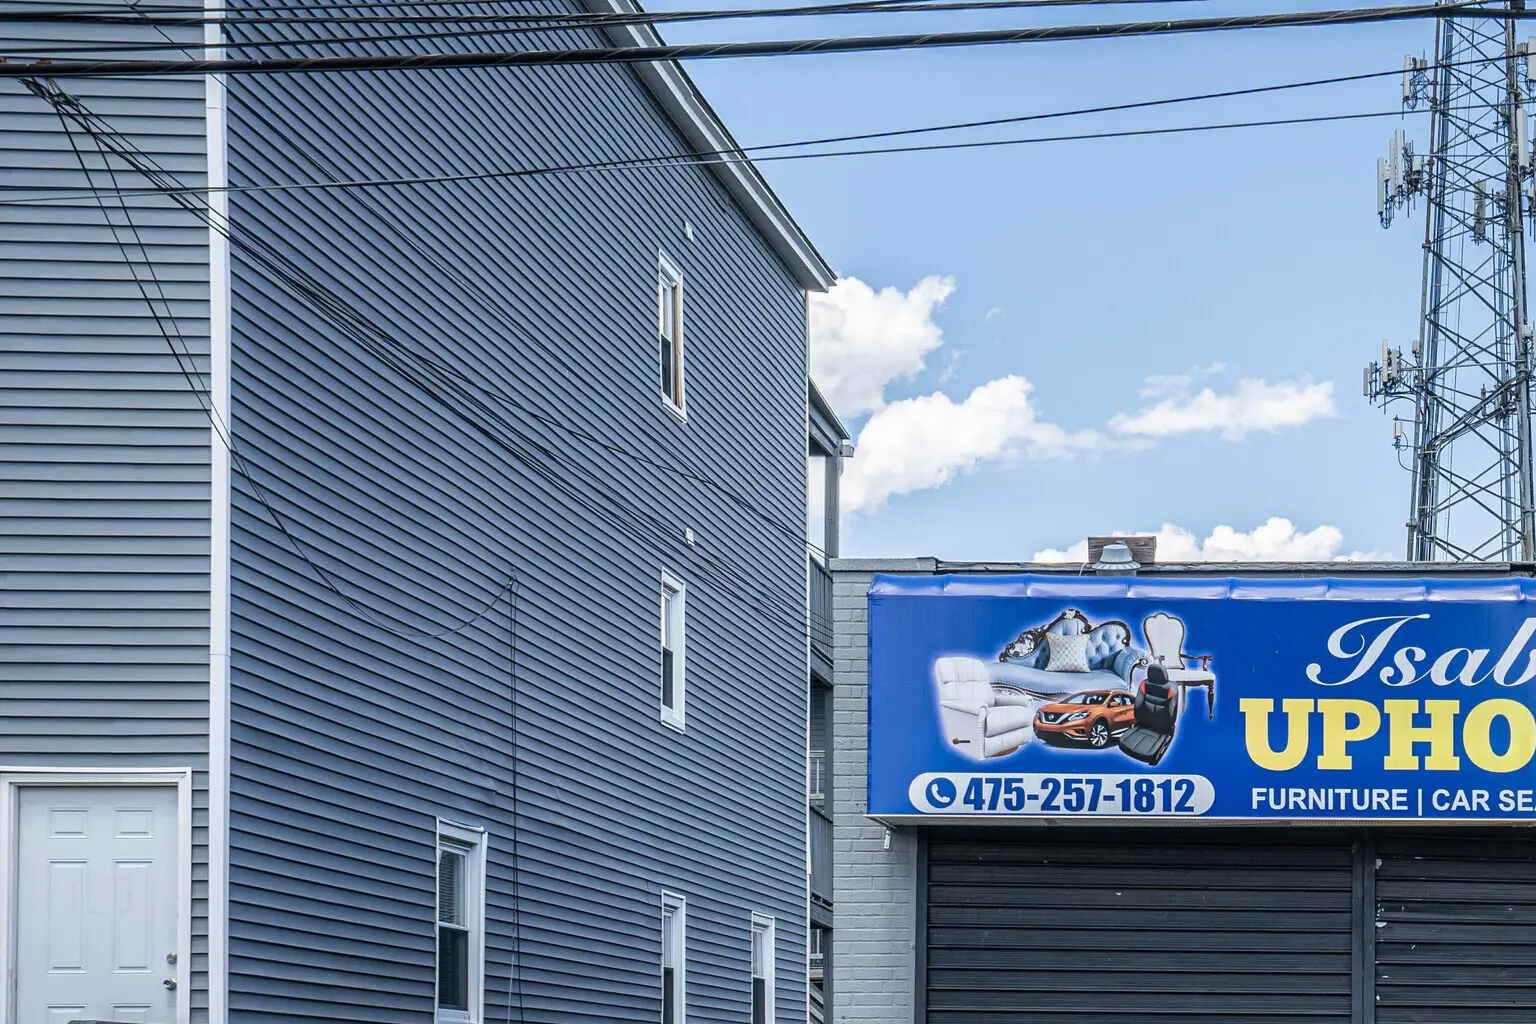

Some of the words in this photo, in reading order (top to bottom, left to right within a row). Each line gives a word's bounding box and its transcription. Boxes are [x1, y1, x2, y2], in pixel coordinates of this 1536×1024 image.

[963, 777, 1196, 813] 475-257-1812
[1252, 788, 1408, 811] FURNITURE
[1432, 789, 1491, 811] CAR
